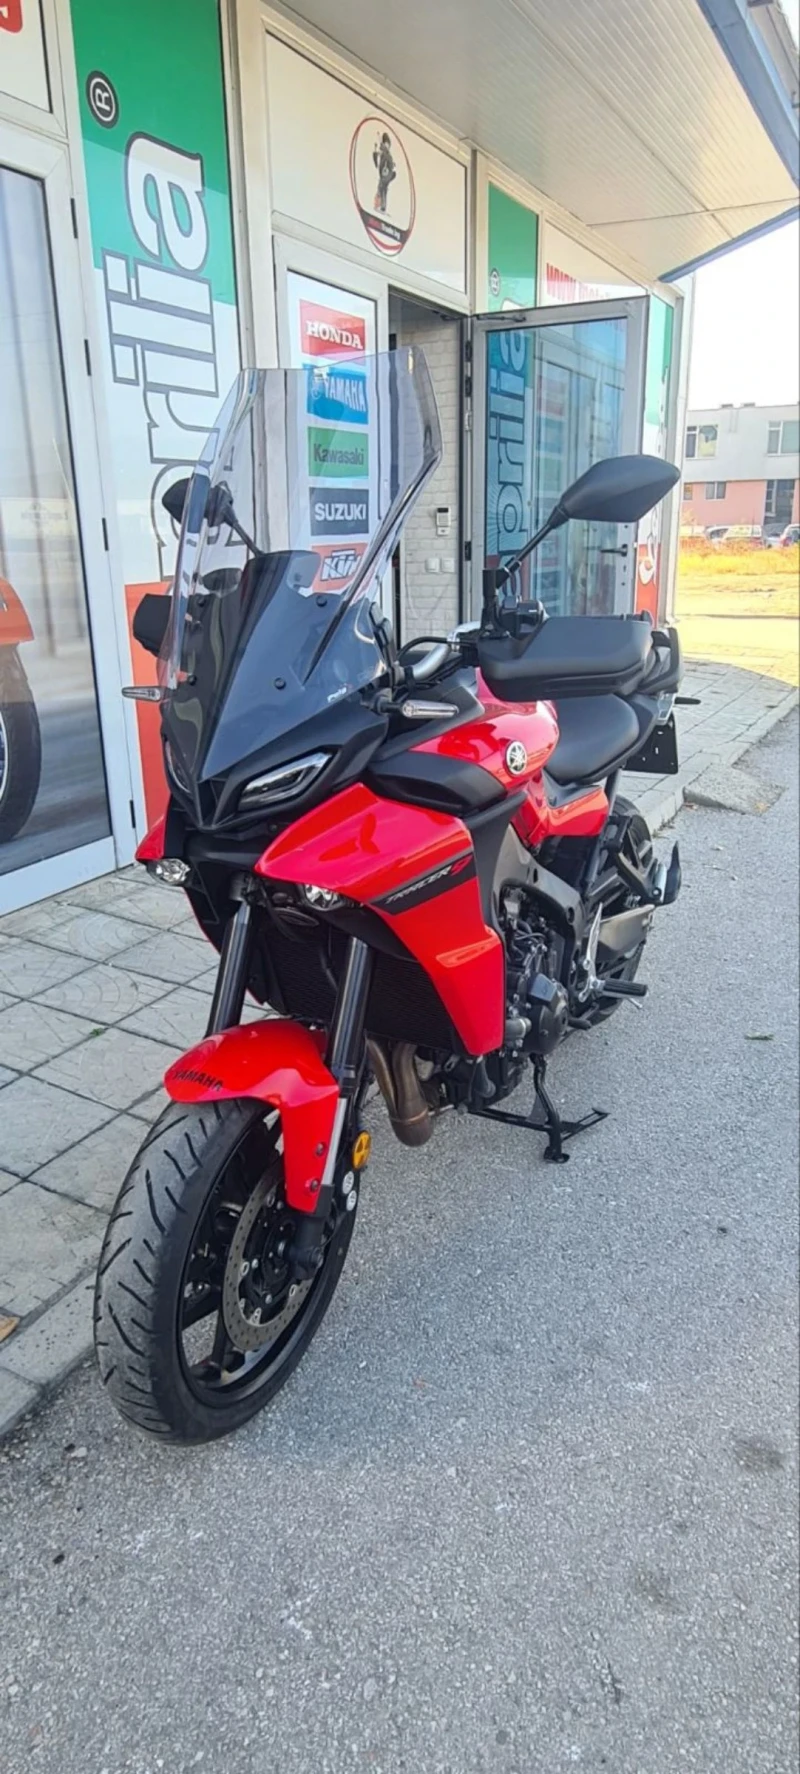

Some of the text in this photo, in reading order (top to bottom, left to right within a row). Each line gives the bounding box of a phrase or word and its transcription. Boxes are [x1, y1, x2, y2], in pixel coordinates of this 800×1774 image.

[305, 320, 364, 350] HONDA
[103, 131, 250, 600] prilia
[322, 375, 367, 413] YAMAHA
[313, 443, 364, 466] Kawasaki
[314, 502, 367, 522] SUZUKI
[173, 1068, 223, 1092] YAMAHA
